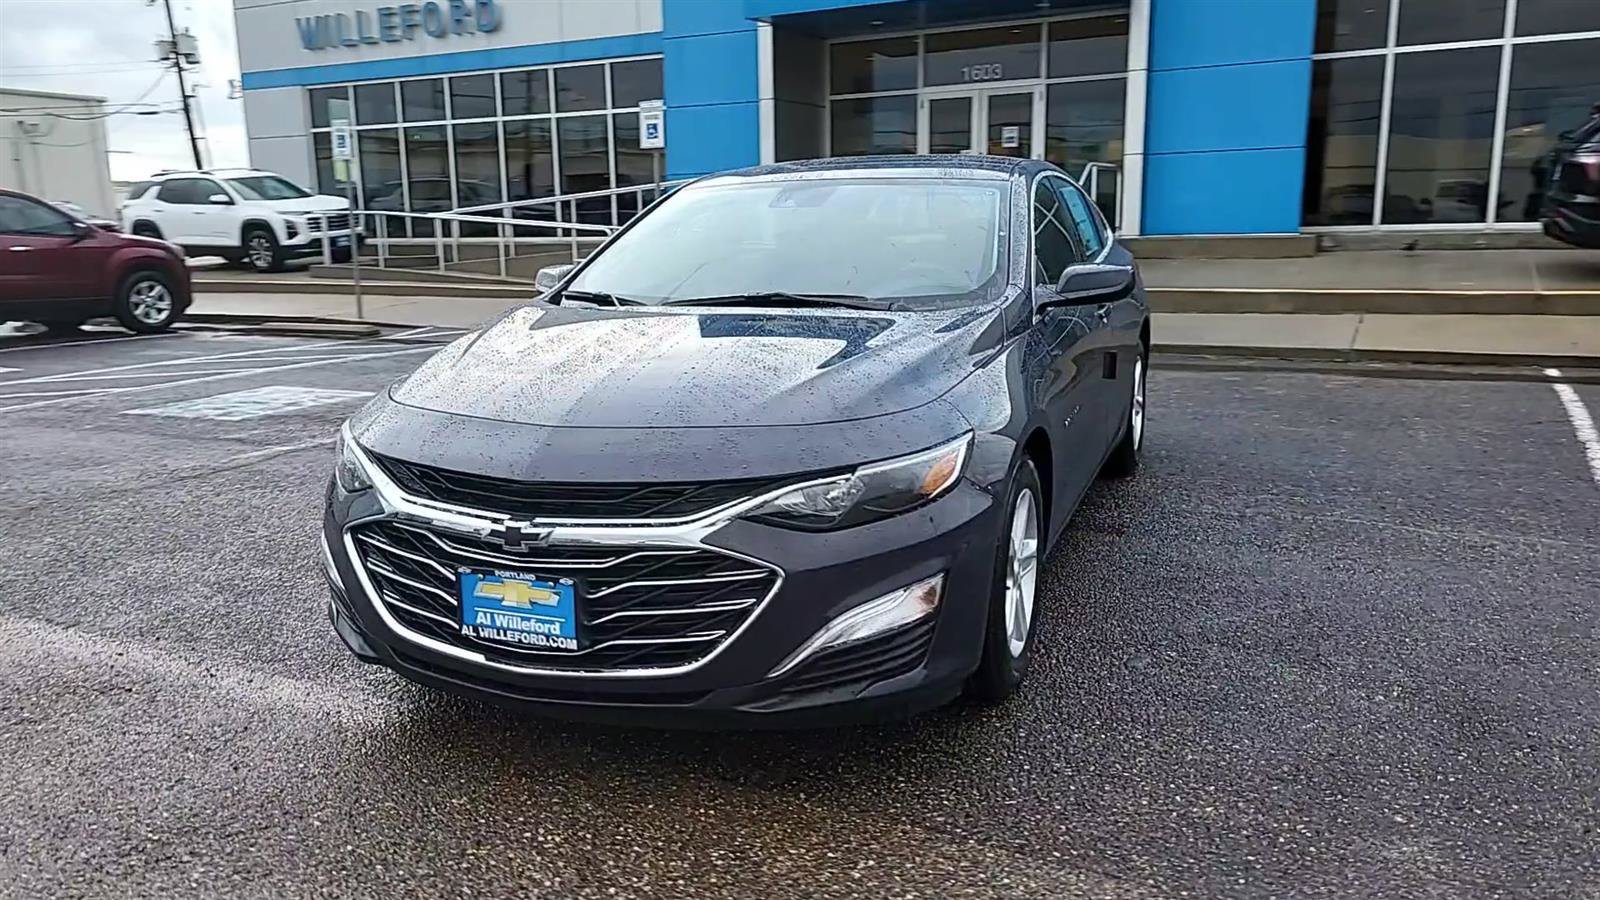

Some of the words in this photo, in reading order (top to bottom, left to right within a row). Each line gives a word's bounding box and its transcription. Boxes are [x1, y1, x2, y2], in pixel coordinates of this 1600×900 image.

[295, 0, 502, 50] WILLEFORD
[494, 569, 536, 581] PORTLAND
[476, 611, 492, 625] Al
[494, 613, 561, 635] Willeford
[461, 624, 477, 637] AL
[479, 626, 578, 650] WILLEFORD.COM
